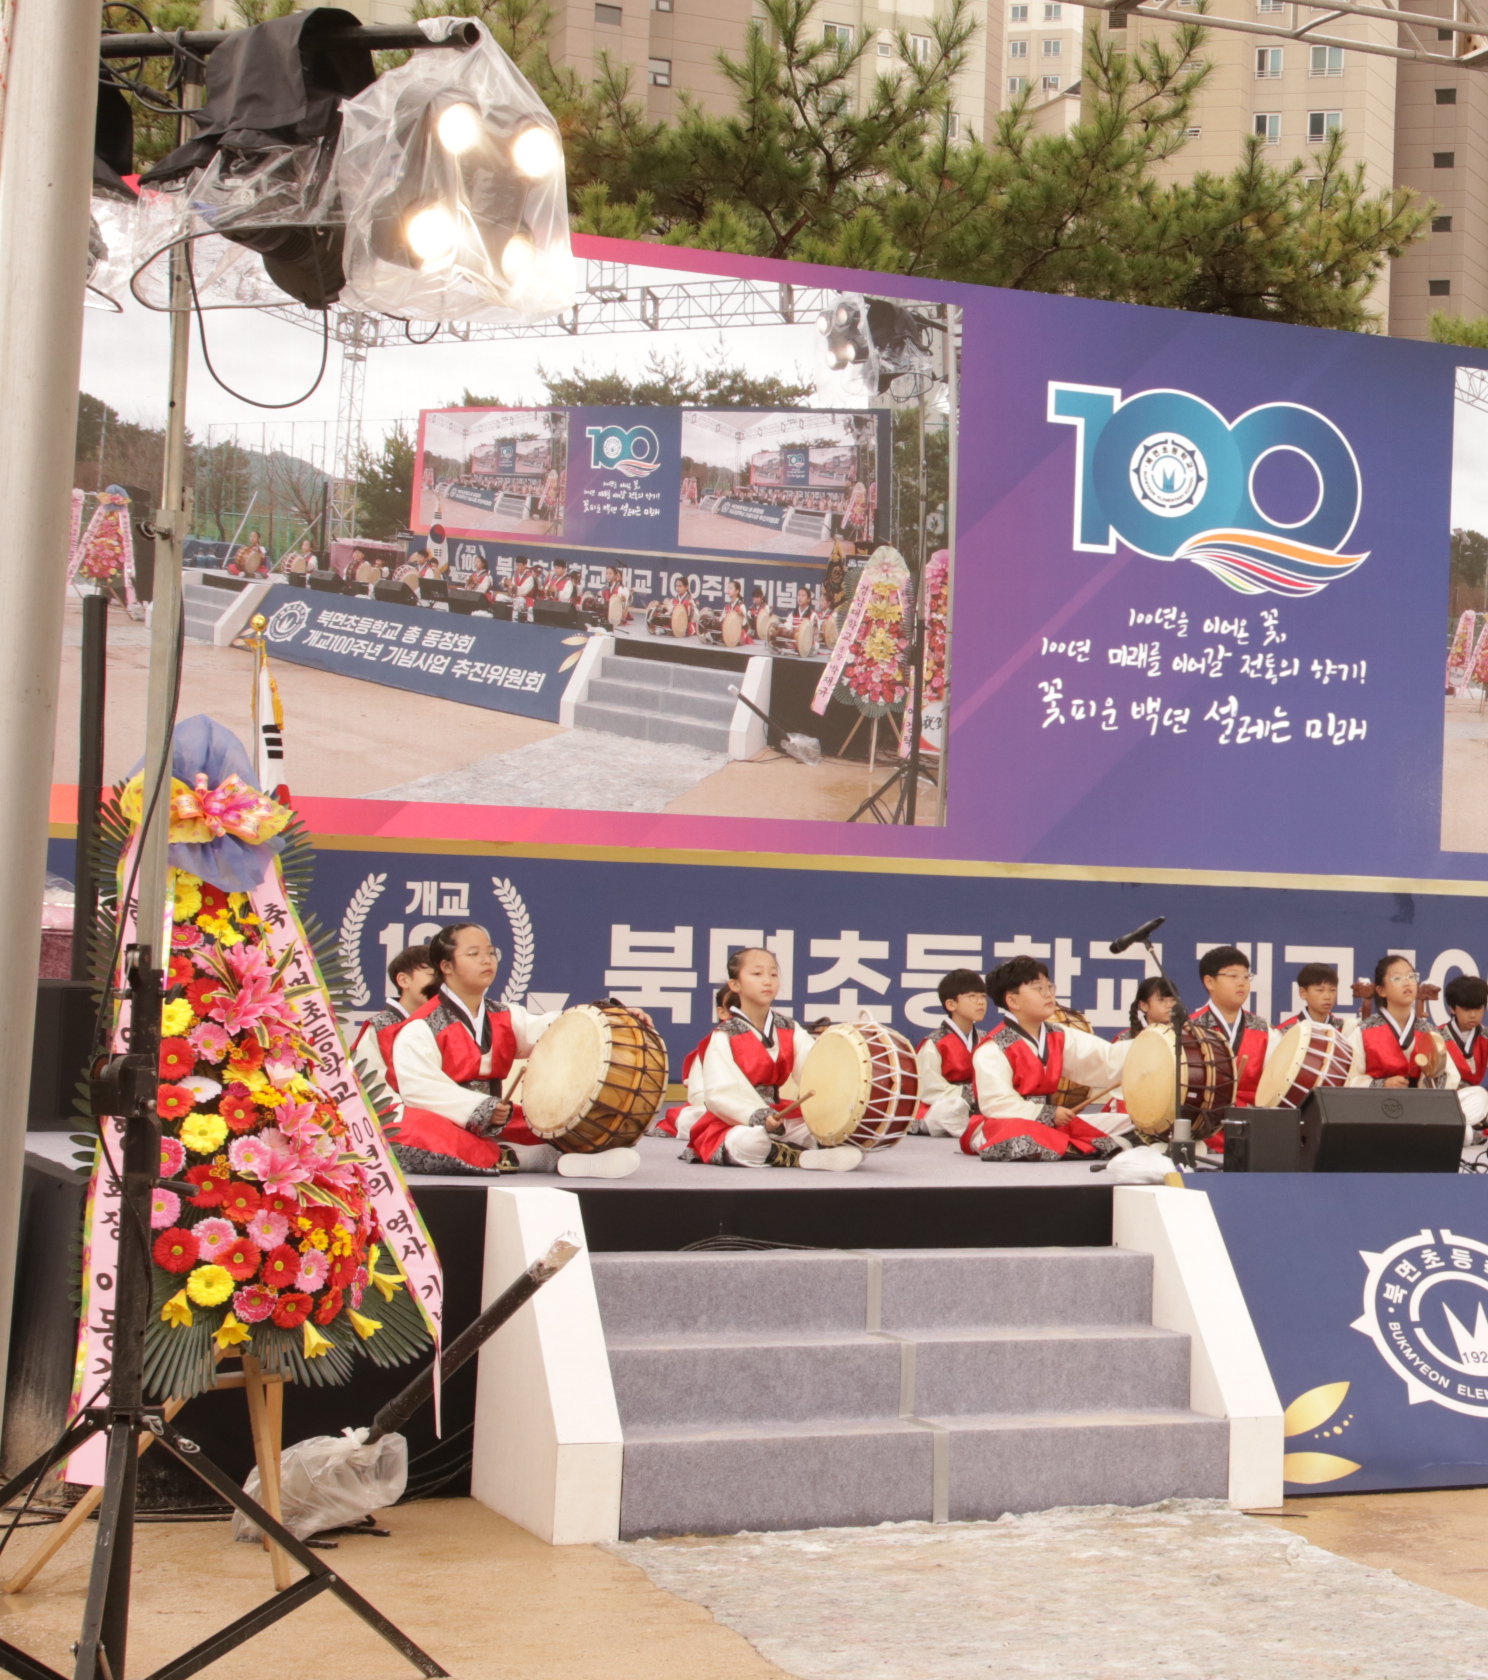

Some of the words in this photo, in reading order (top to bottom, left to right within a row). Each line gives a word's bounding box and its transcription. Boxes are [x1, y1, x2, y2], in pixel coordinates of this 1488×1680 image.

[586, 425, 659, 469] 100
[1047, 381, 1362, 561] 100
[317, 609, 403, 641] 북면초등학교
[401, 626, 423, 644] 총
[421, 628, 476, 654] 동창회
[1129, 606, 1189, 637] 100년을
[1203, 616, 1249, 645] 이어온
[302, 629, 384, 661] 개교100주년
[381, 645, 452, 675] 기념사업
[451, 659, 546, 693] 추진위원회
[1041, 637, 1091, 662] 100년
[1108, 641, 1162, 676] 미래를
[1172, 645, 1233, 678] 이어갈
[1240, 653, 1299, 685] 전통의
[1311, 659, 1367, 684] 향기!
[1038, 678, 1118, 731] 꽃피운
[1131, 697, 1190, 736] 백년
[1204, 695, 1291, 744] 설레는
[1305, 713, 1367, 746] 미래
[405, 881, 470, 916] 개교
[263, 903, 287, 929] 축
[351, 1116, 395, 1195] 00년의
[386, 1209, 427, 1262] 역사
[1389, 1321, 1450, 1389] BUKMYEON
